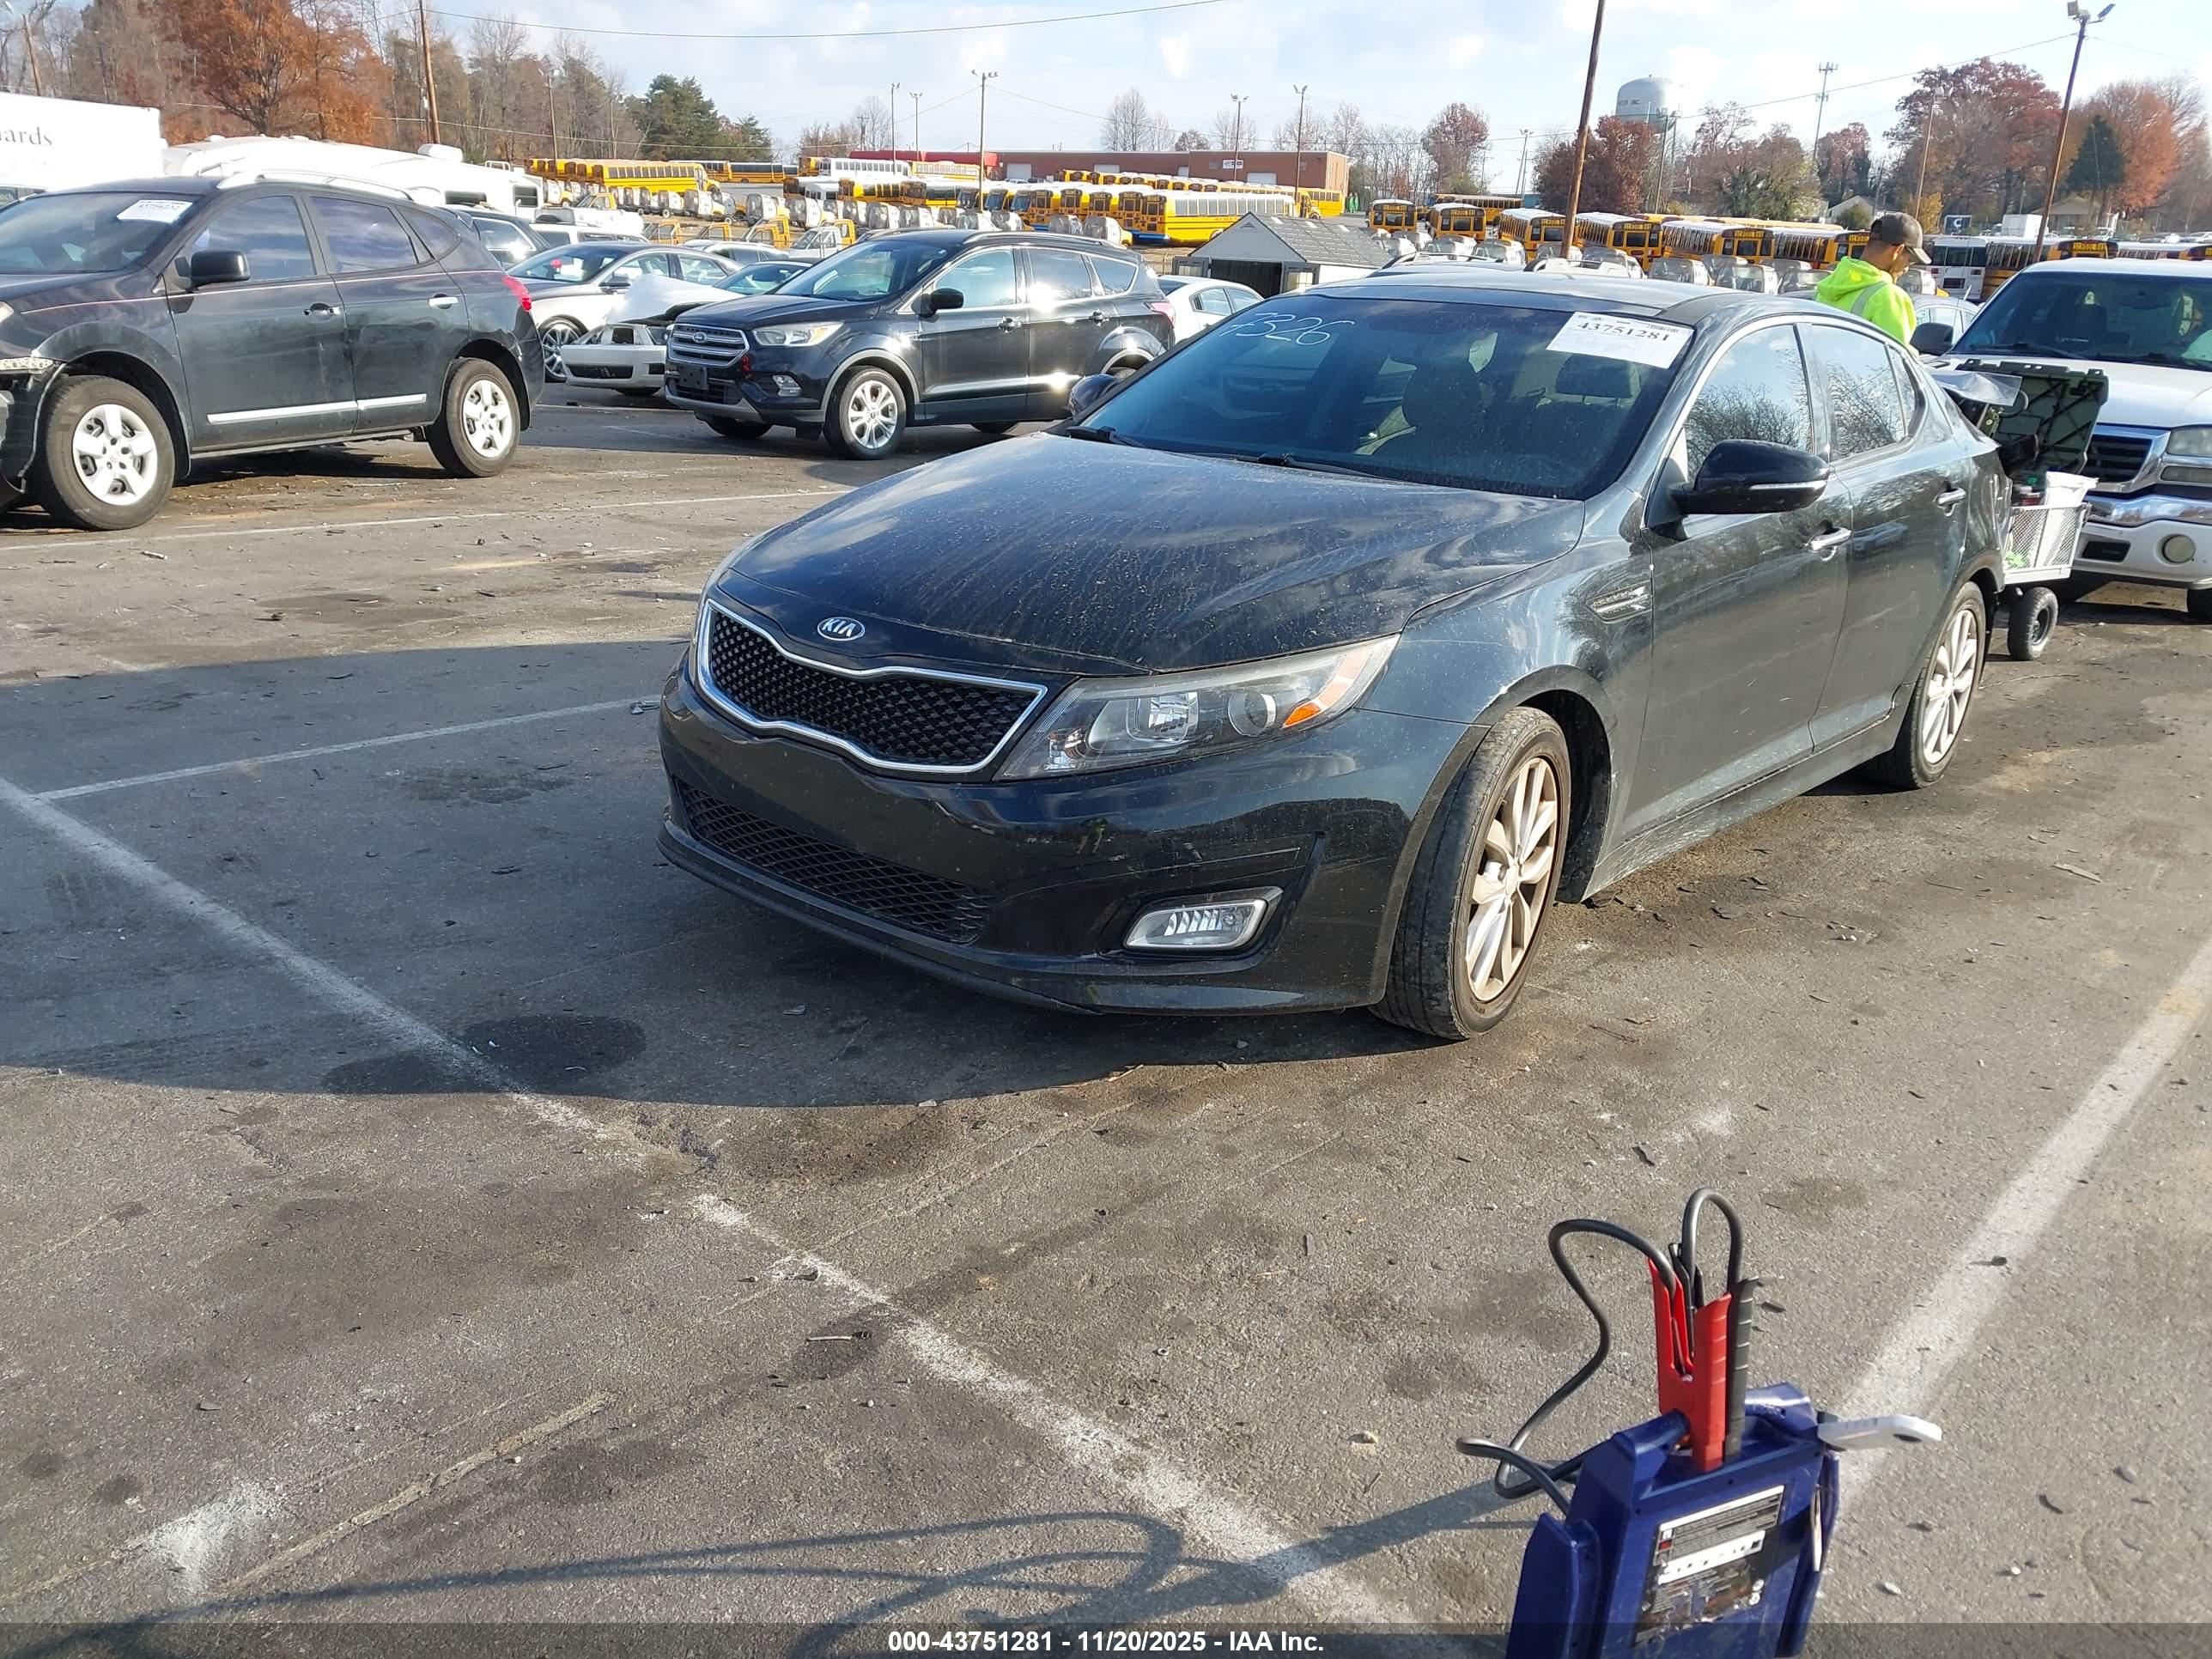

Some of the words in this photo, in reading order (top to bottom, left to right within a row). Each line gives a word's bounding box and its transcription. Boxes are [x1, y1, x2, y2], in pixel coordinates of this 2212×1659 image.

[0, 126, 52, 146] ards
[1219, 312, 1355, 345] 7326
[1577, 322, 1669, 342] 43751281
[822, 618, 856, 637] KIA
